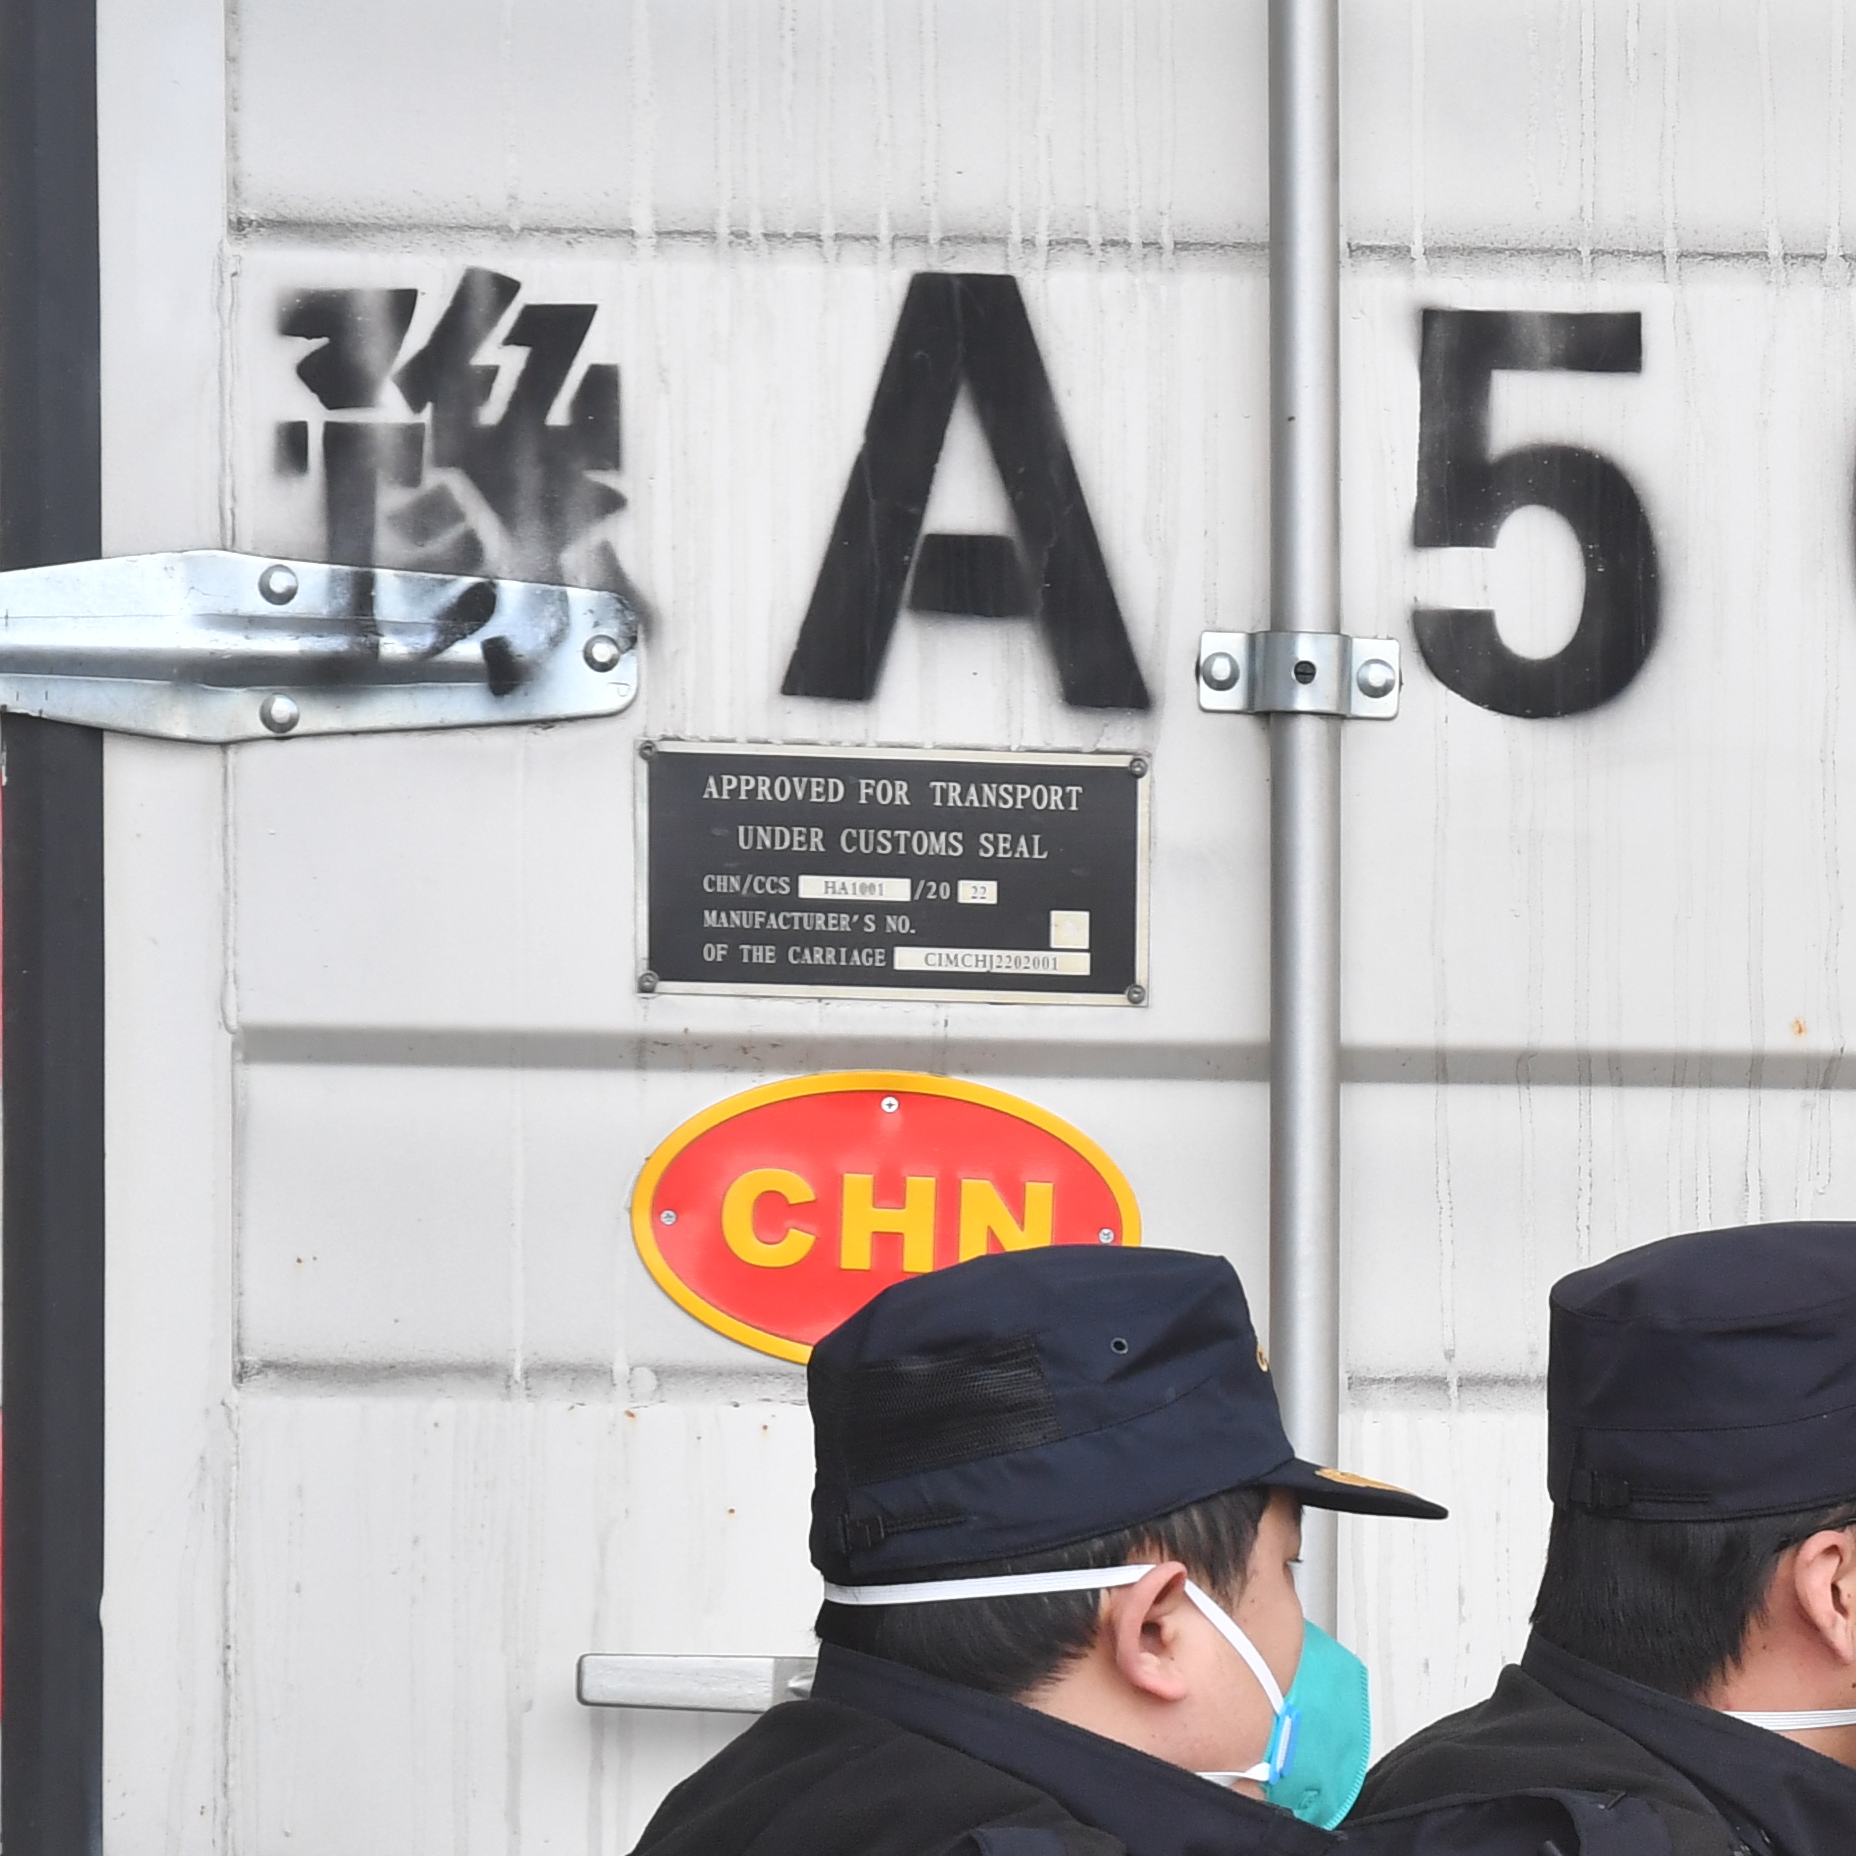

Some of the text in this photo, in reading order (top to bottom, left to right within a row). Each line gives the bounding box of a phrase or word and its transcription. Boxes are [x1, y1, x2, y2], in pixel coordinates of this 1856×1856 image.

[703, 775, 1083, 810] APPROVED FOR TRANSPORT
[737, 825, 1048, 859] UNDER CUSTOMS SEAL
[703, 874, 791, 896] CHN/CCS
[885, 915, 916, 934] NO.
[703, 944, 728, 962] OF
[740, 944, 776, 964] THE
[788, 946, 886, 967] CARRIAGE
[721, 1167, 1055, 1274] CHN
